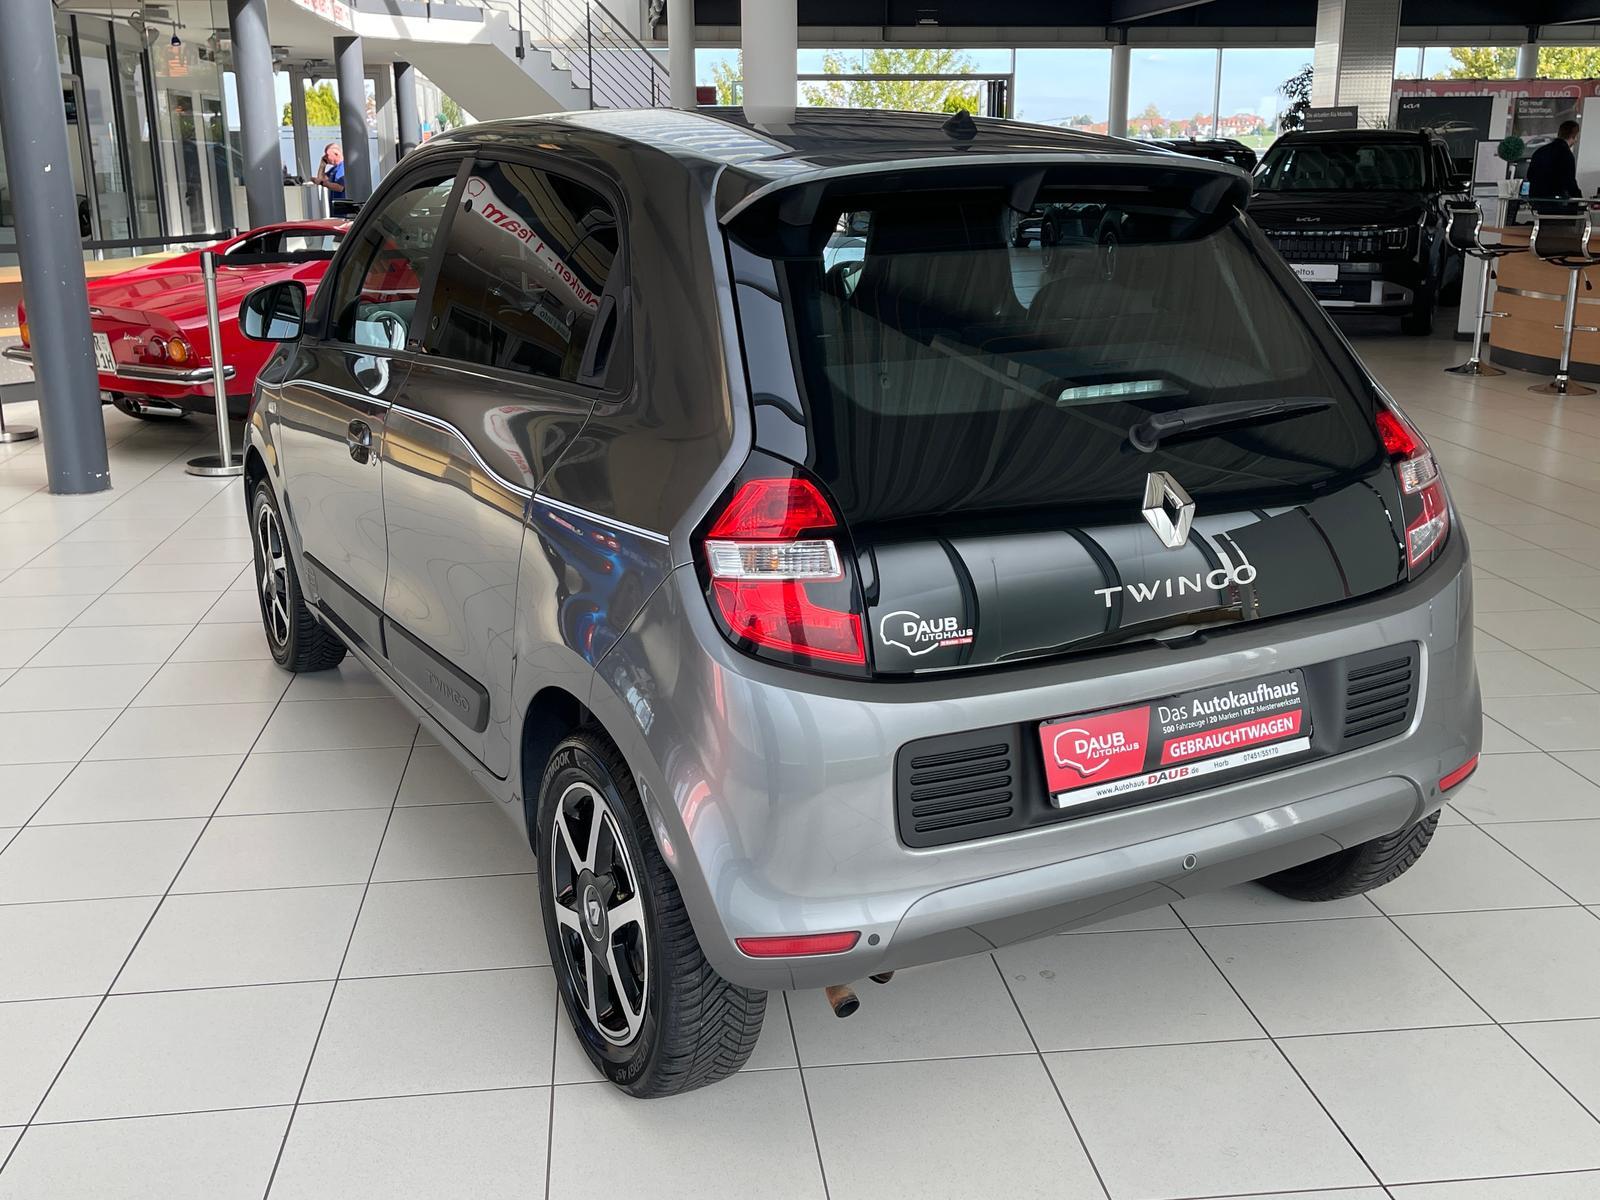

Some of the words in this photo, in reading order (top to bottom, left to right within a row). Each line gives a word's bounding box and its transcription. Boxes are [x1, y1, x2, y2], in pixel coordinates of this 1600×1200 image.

[1294, 268, 1315, 276] eltos
[1094, 564, 1257, 608] TWINGO
[903, 617, 958, 642] DAUB
[1158, 705, 1189, 724] Das
[1192, 681, 1299, 717] Autokaufhaus
[1162, 725, 1175, 734] 500
[1176, 719, 1206, 731] Fahrzeuge
[1209, 716, 1218, 724] 20
[1218, 711, 1240, 722] Marken
[1075, 731, 1125, 759] DAUB
[1170, 716, 1294, 758] GEBRAUCHTWAGEN
[1213, 759, 1230, 770] Horb
